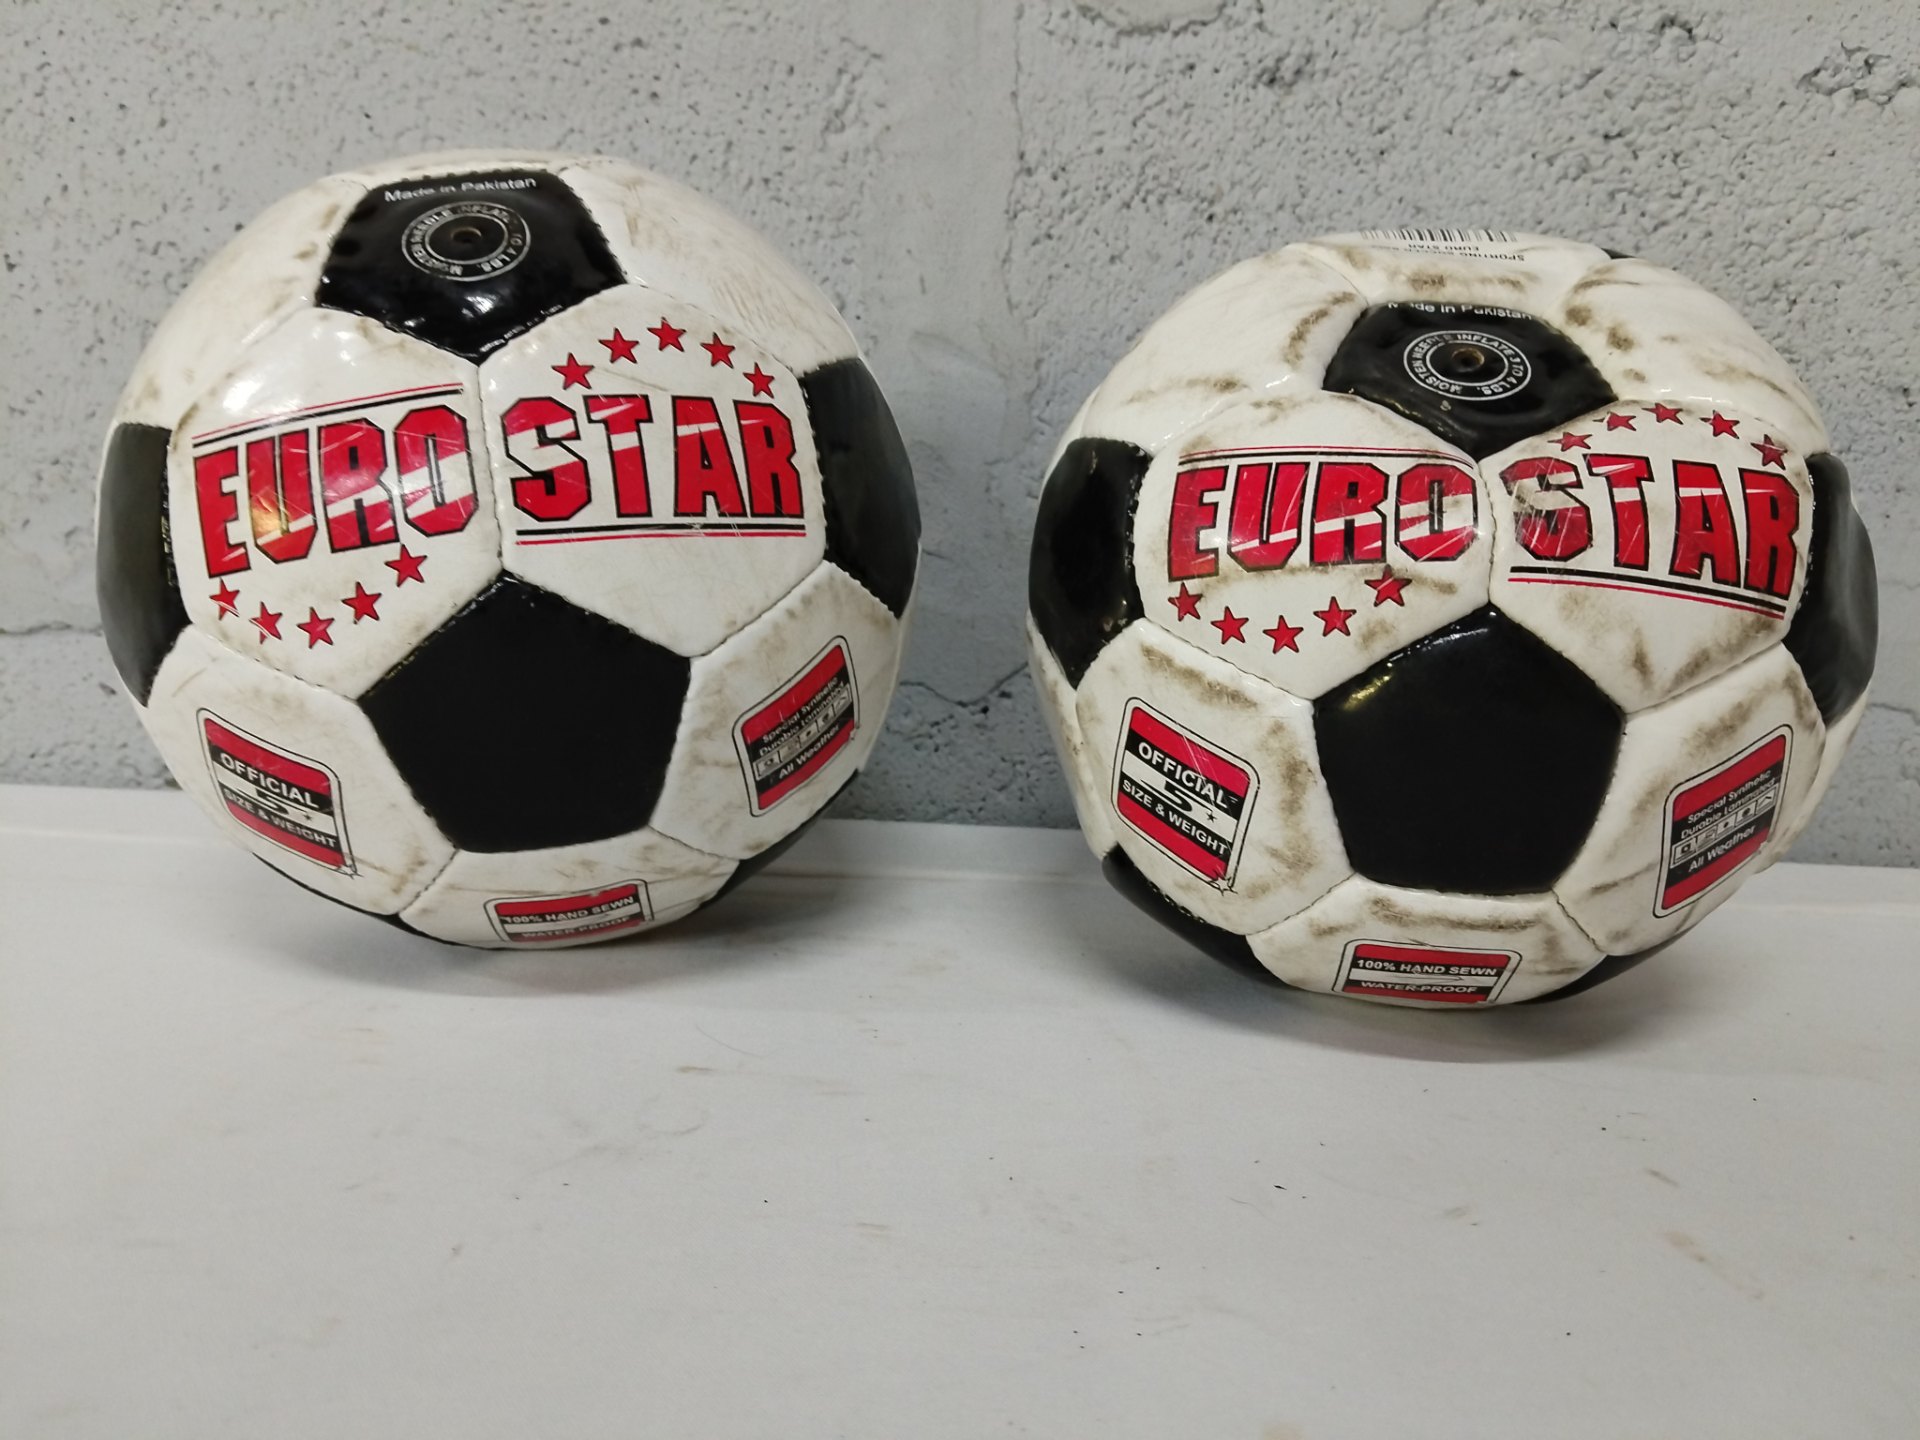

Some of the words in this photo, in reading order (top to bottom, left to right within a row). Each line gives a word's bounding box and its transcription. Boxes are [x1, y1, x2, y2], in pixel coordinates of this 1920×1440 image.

[384, 188, 436, 202] Made
[440, 185, 457, 193] in
[461, 178, 537, 192] Pakistan
[1388, 302, 1435, 313] Mde
[1412, 360, 1464, 395] MOISTEN
[1457, 333, 1516, 356] INFLATE
[1512, 364, 1524, 377] TO
[193, 404, 480, 578] EURO
[502, 394, 806, 522] STAR
[1167, 461, 1479, 582] EURO
[1500, 453, 1802, 600] STAR
[762, 711, 800, 744] Special
[779, 764, 794, 780] All
[795, 724, 841, 766] Weather
[220, 752, 320, 809] OFFICIAL
[1138, 741, 1228, 809] OFFICIAL
[223, 788, 254, 814] SIZE
[270, 814, 337, 848] WEIGHT
[1122, 779, 1153, 808] SIZE
[1155, 803, 1165, 817] &
[1168, 810, 1228, 855] WEIGHT
[1681, 811, 1722, 840] Durable
[1687, 796, 1727, 825] Special
[1688, 856, 1704, 873] All
[1706, 824, 1756, 862] Weather
[545, 910, 589, 922] HAND
[591, 896, 634, 914] SEWN
[1357, 959, 1396, 971] 100%
[1400, 964, 1446, 975] HAND
[1448, 966, 1498, 976] SEWN
